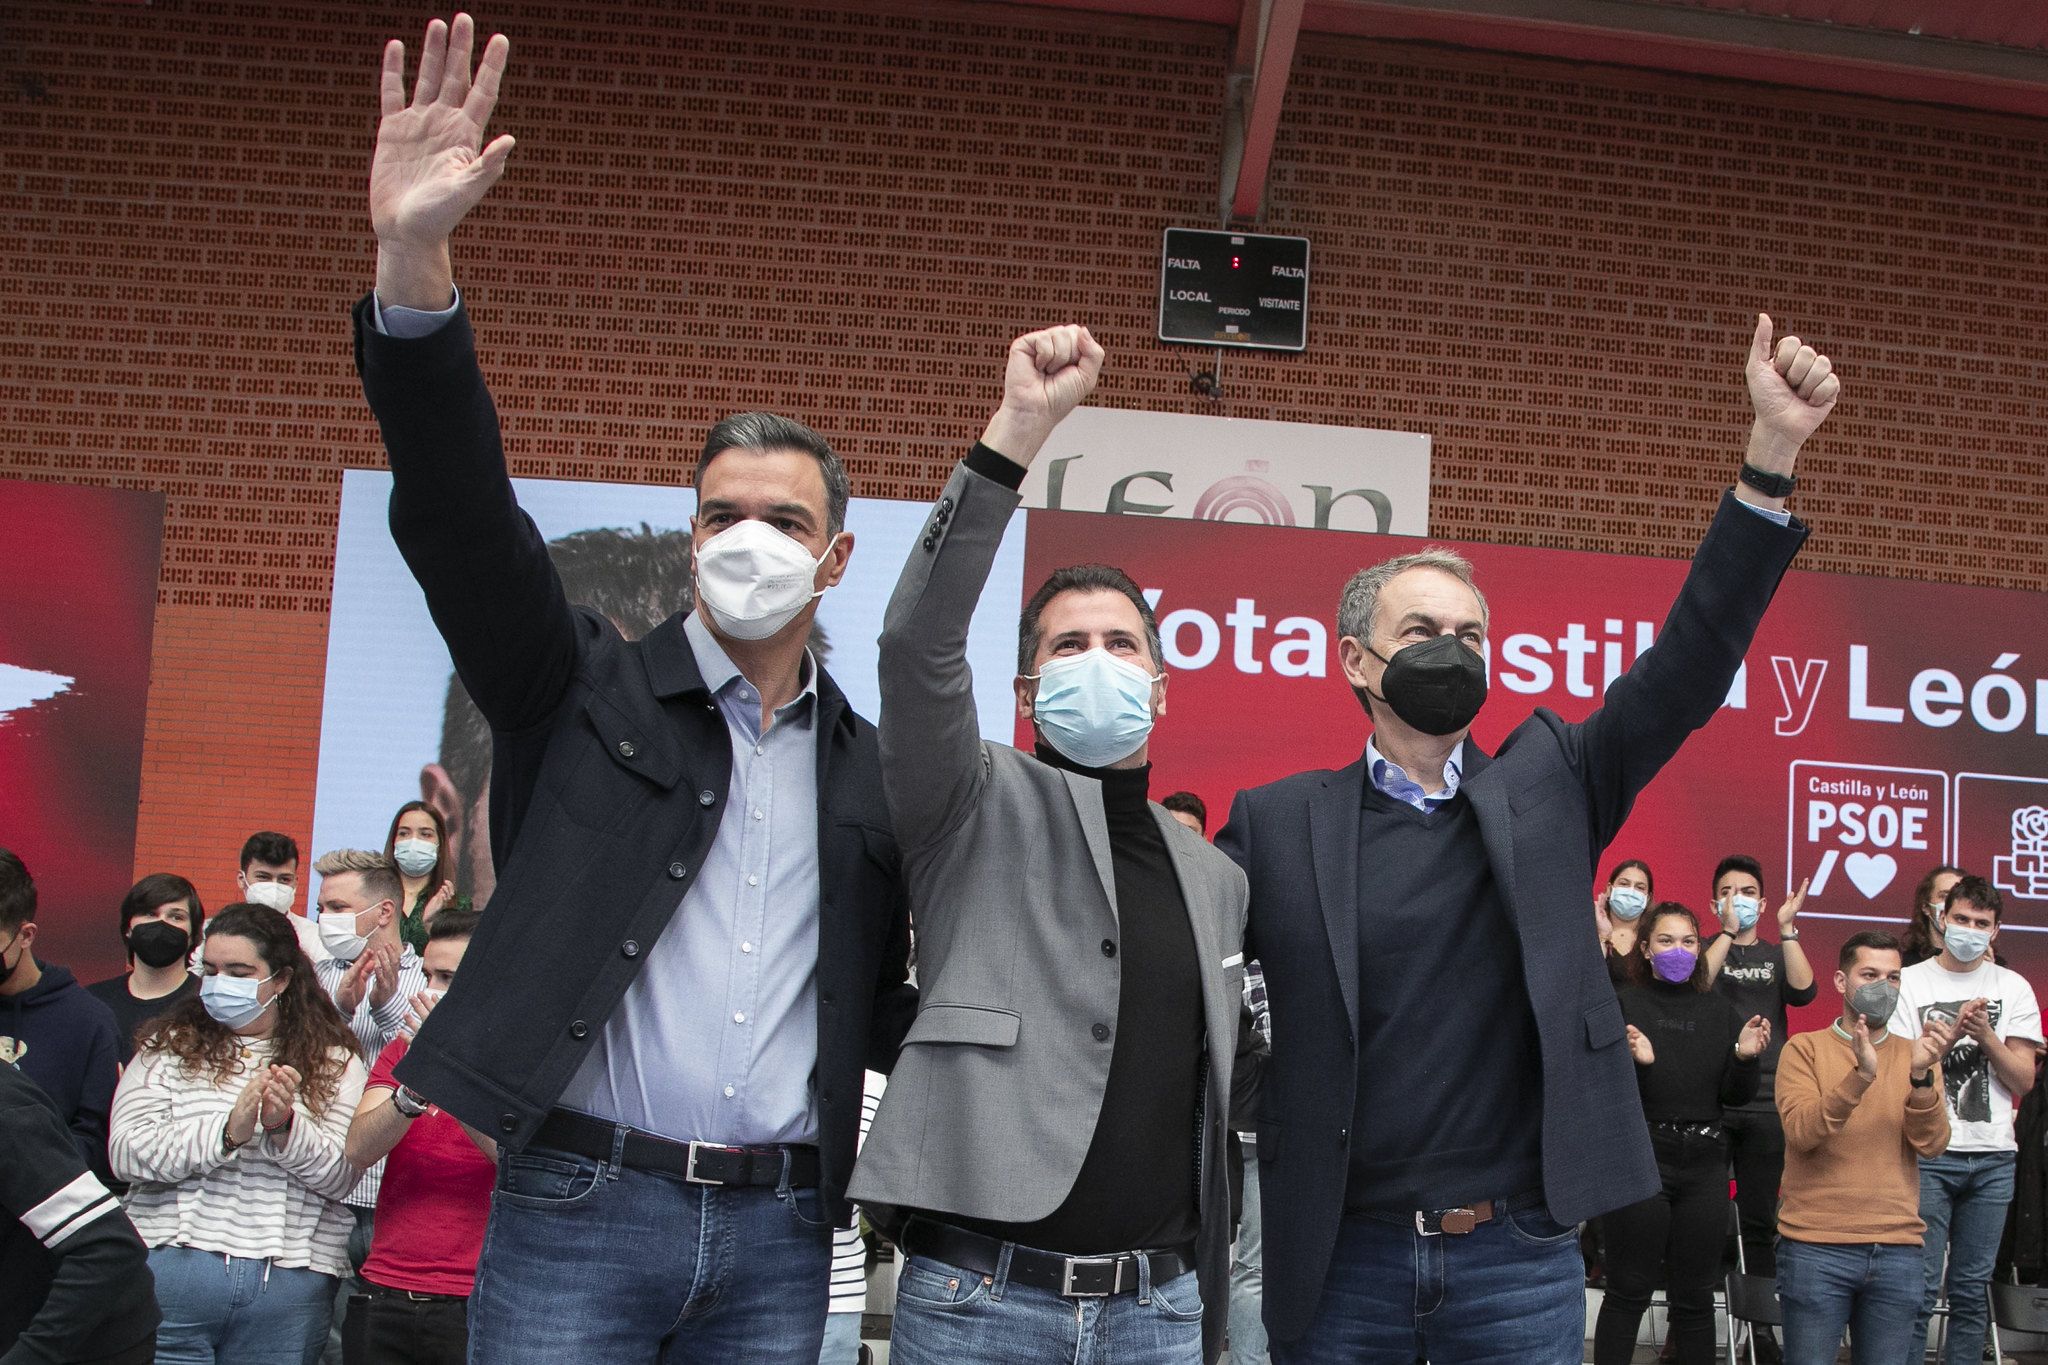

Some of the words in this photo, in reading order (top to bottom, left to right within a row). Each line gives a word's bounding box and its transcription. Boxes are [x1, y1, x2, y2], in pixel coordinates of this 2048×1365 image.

[1167, 257, 1201, 270] FALTA
[1271, 265, 1305, 278] FALTA
[1169, 290, 1212, 303] LOCAL
[1258, 297, 1301, 311] VISITANTE
[1218, 306, 1251, 316] PERIODO
[1771, 656, 1828, 736] y
[1848, 644, 2048, 735] Leó
[1808, 776, 1872, 797] Castilla
[1876, 785, 1886, 801] y
[1890, 782, 1929, 801] León
[1808, 800, 1928, 850] PSOE
